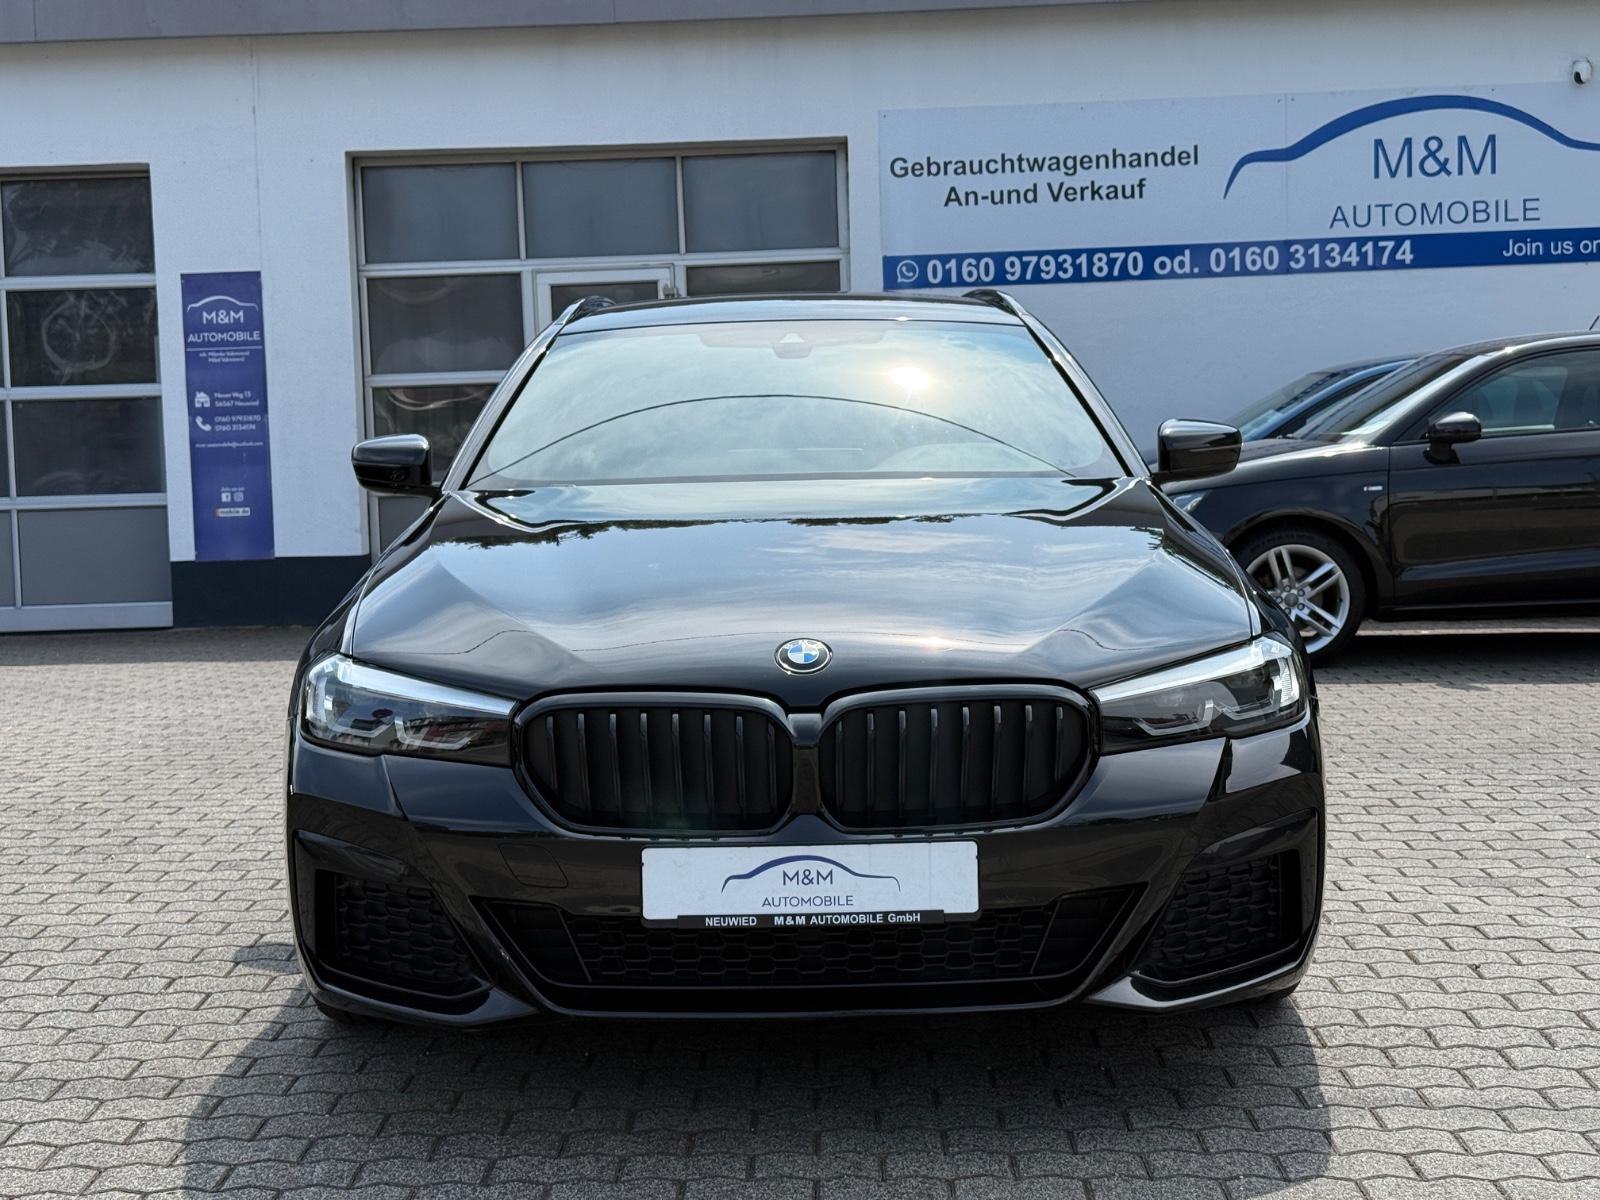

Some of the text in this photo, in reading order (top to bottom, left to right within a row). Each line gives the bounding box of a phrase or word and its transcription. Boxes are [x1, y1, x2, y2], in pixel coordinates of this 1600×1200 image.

[890, 145, 1199, 178] Gebrauchtwagenhandel
[1373, 134, 1496, 179] M&M
[944, 178, 1147, 207] An-und Verkauf
[1330, 198, 1541, 229] AUTOMOBILE
[1502, 237, 1543, 258] Join
[1551, 239, 1573, 255] us
[926, 240, 1414, 284] 0160 97931870 od. 0160 3134174
[202, 310, 244, 325] M&M
[187, 331, 261, 343] AUTOMOBILE
[782, 869, 833, 886] M&M
[761, 895, 854, 908] AUTOMOBILE
[705, 912, 921, 927] NEUWIED M&M AUTOMOBILE GmbH
